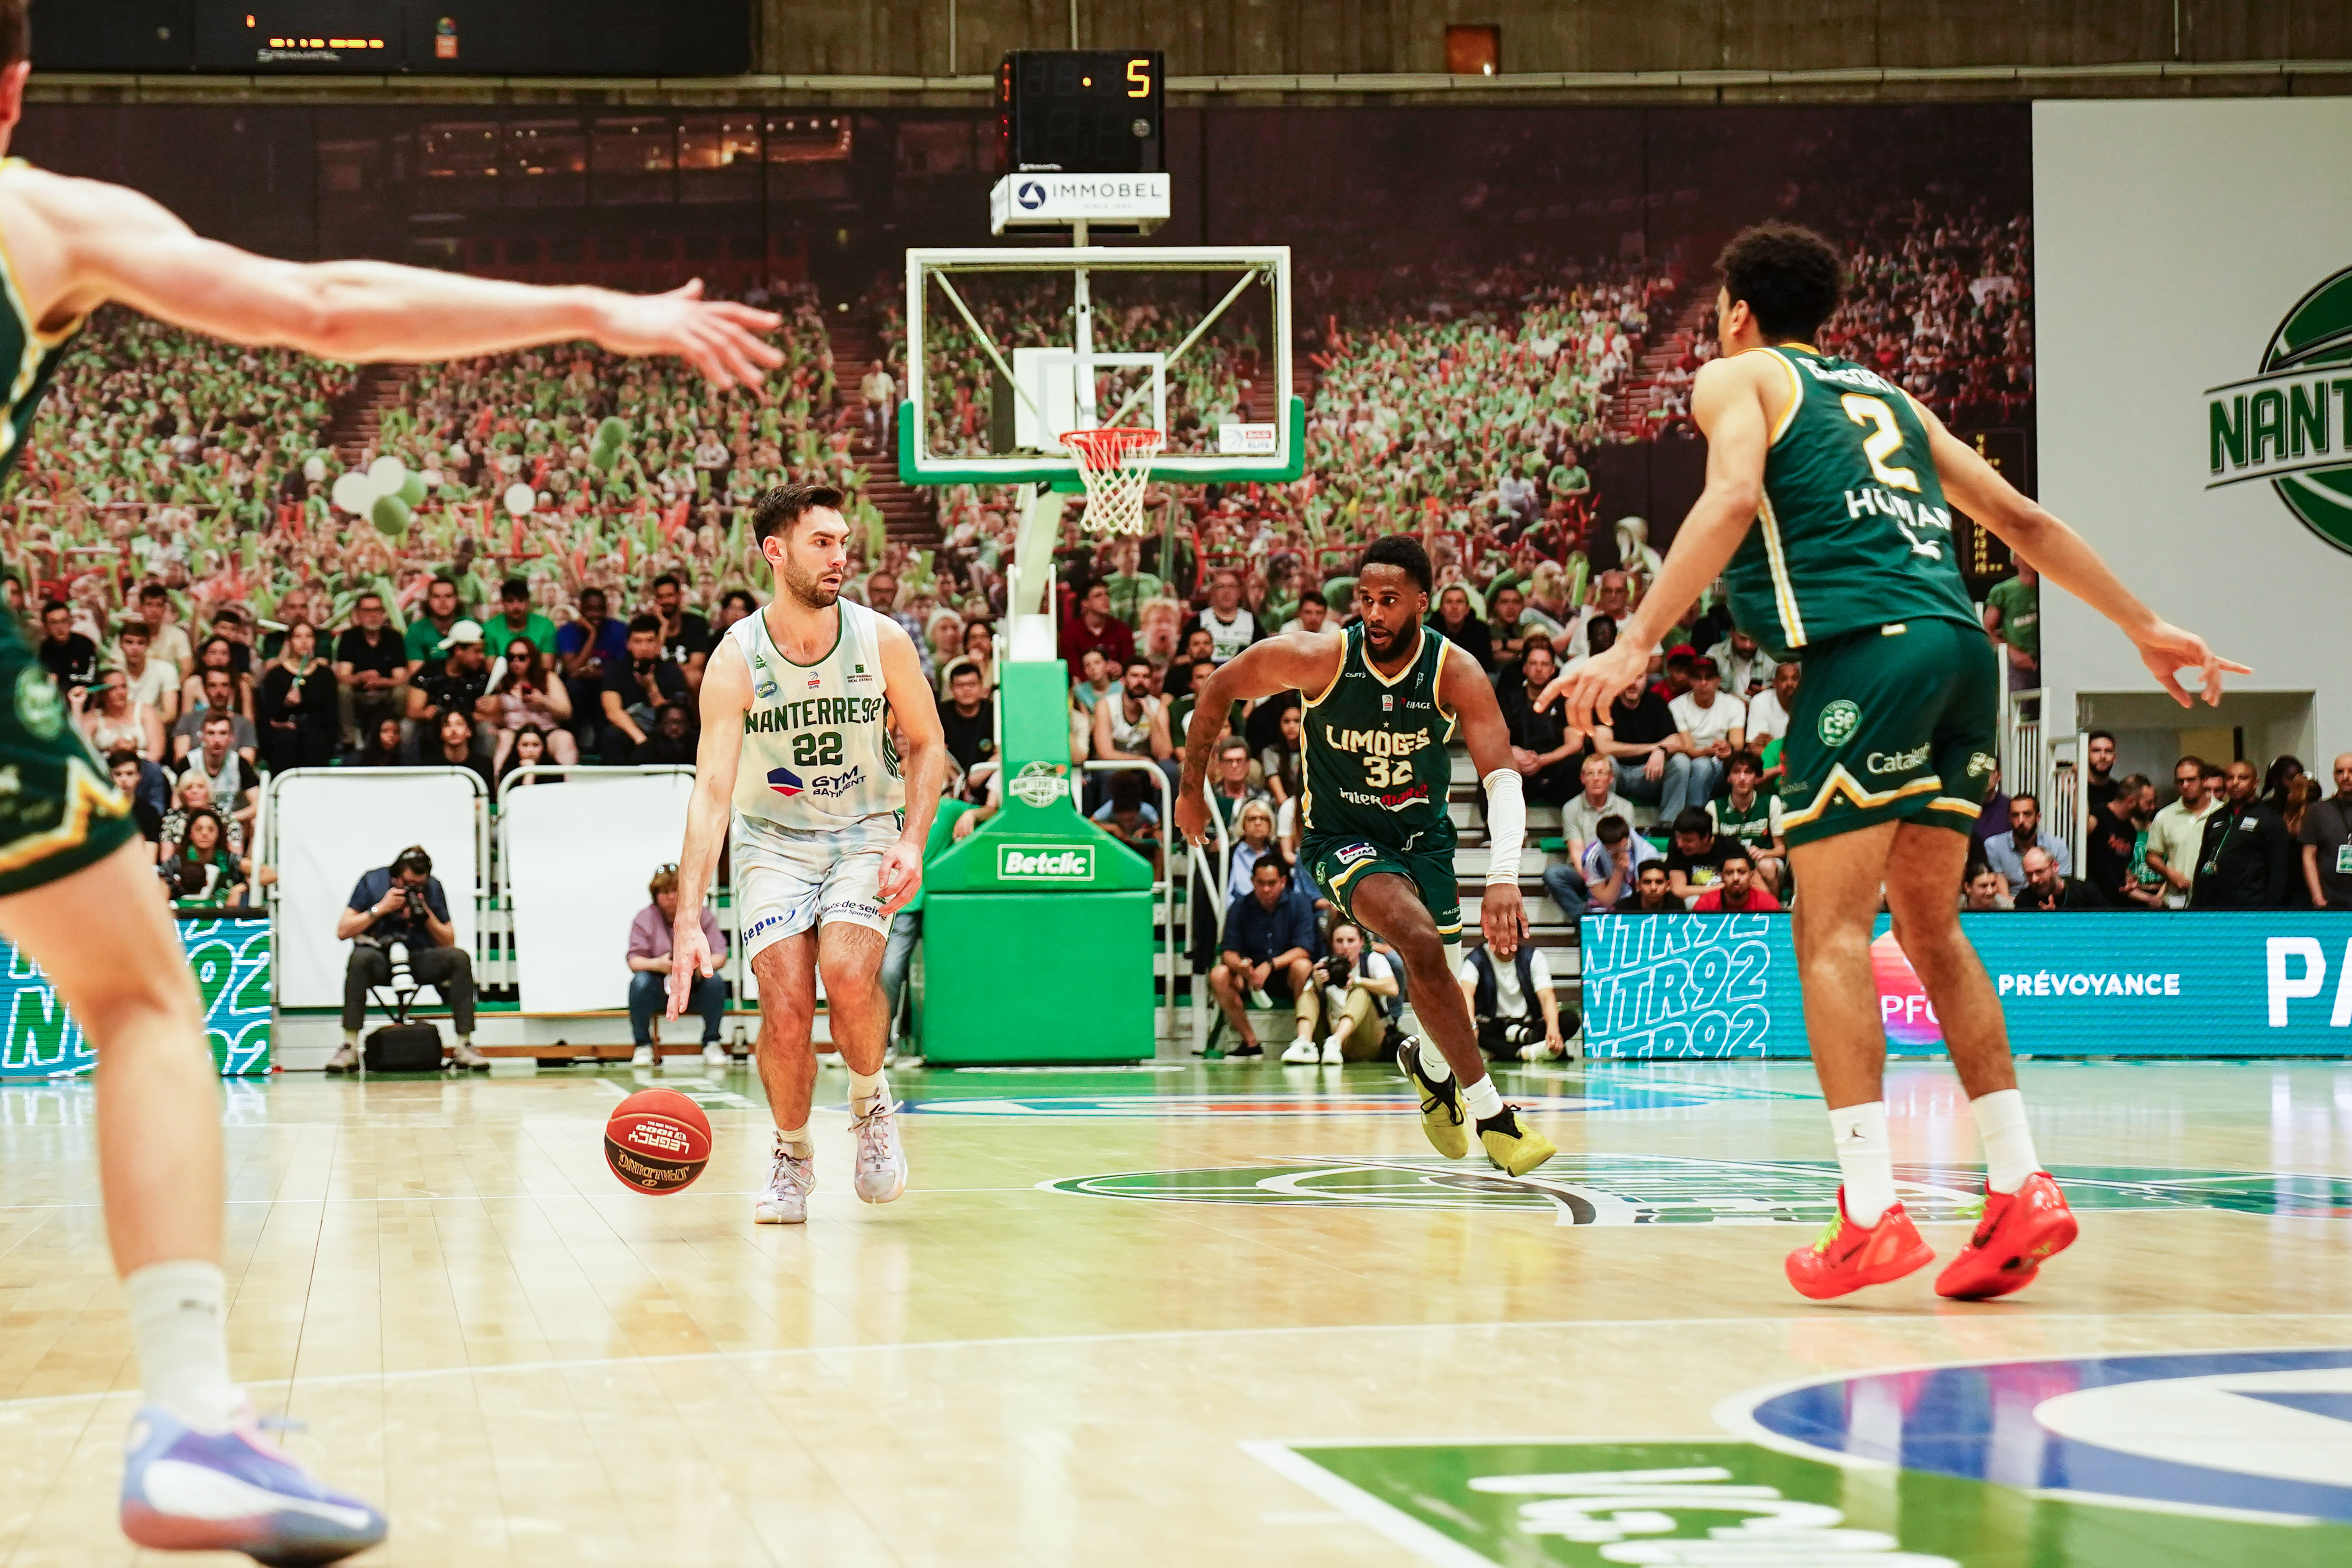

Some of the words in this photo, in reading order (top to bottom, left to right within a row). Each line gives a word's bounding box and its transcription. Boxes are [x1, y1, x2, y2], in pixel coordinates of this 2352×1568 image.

[1052, 183, 1163, 198] IMMOBEL
[1840, 392, 1921, 493] 2
[1844, 488, 1952, 531] HUMAN
[792, 732, 843, 767] 22
[1325, 724, 1431, 758] LIMOGES
[812, 764, 859, 790] GYM
[1363, 756, 1413, 788] 32
[813, 775, 867, 798] BATIMENT
[1005, 851, 1087, 874] Betclic
[848, 909, 872, 919] Sportif
[1998, 970, 2180, 997] PRÉVOYANCE
[628, 1130, 690, 1154] LEGACY
[617, 1149, 689, 1182] SPALDING
